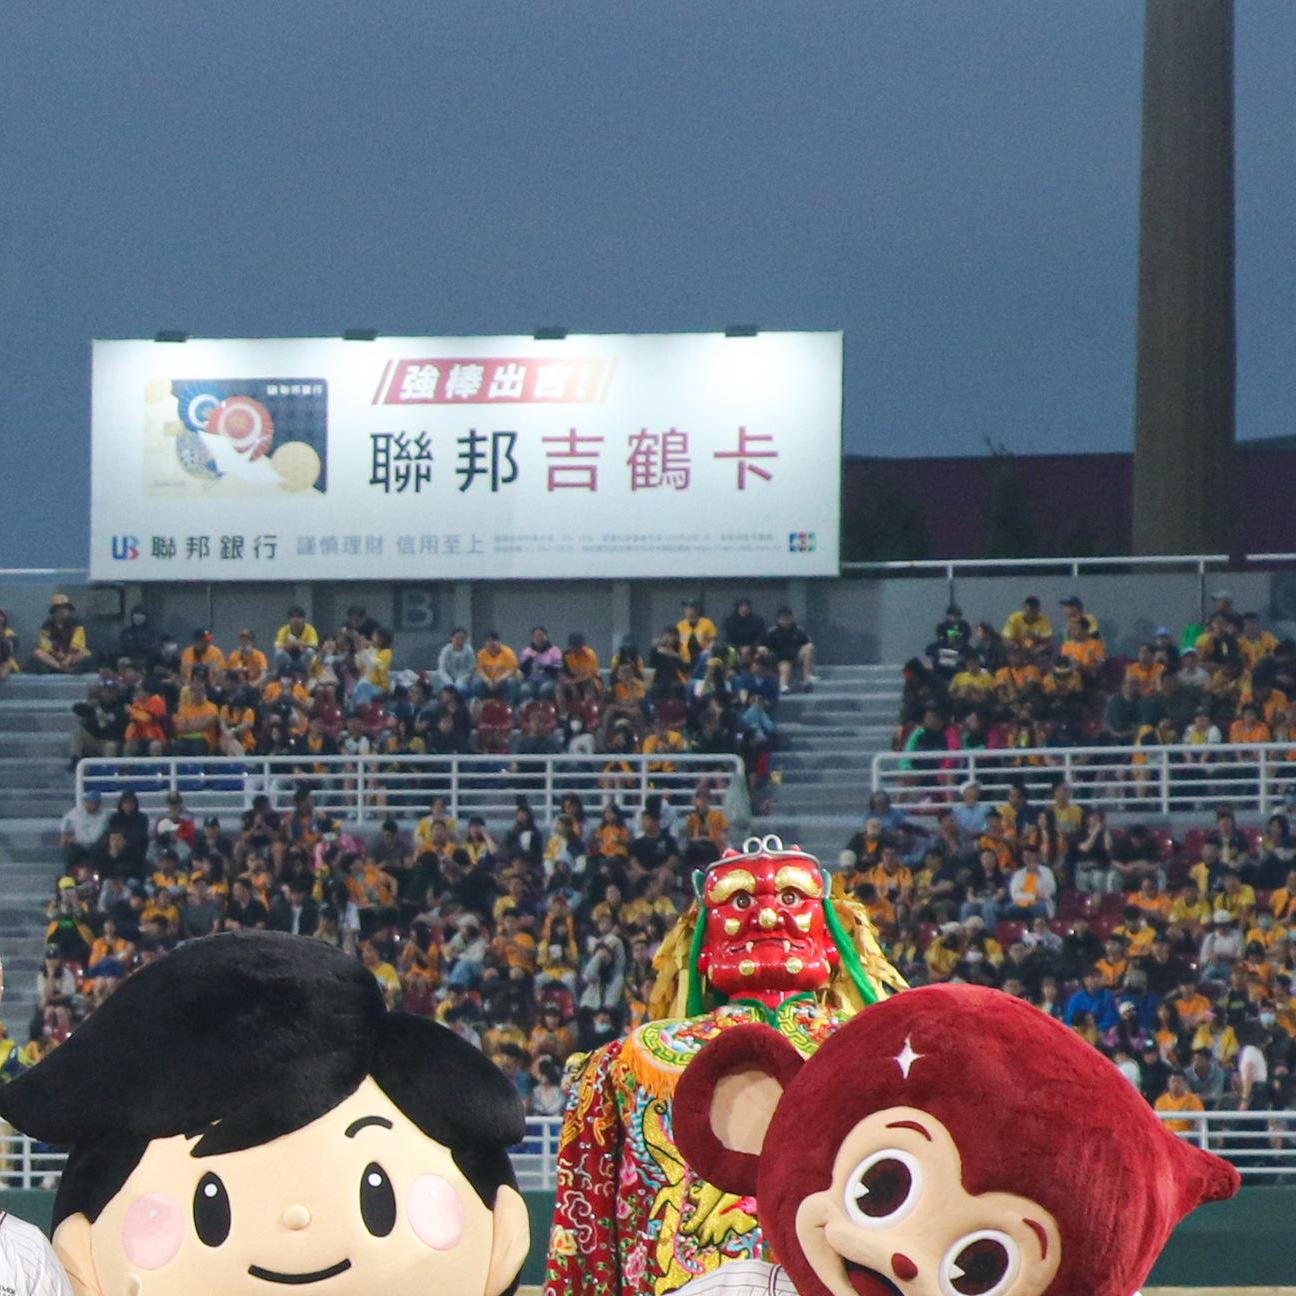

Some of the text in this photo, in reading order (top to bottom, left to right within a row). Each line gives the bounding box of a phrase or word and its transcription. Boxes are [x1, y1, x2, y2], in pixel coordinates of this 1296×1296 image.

[369, 426, 779, 493] 聯邦吉鶴卡
[151, 535, 278, 560] 聯邦銀行
[297, 534, 385, 556] 謹慎理財
[396, 534, 484, 555] 信用至上
